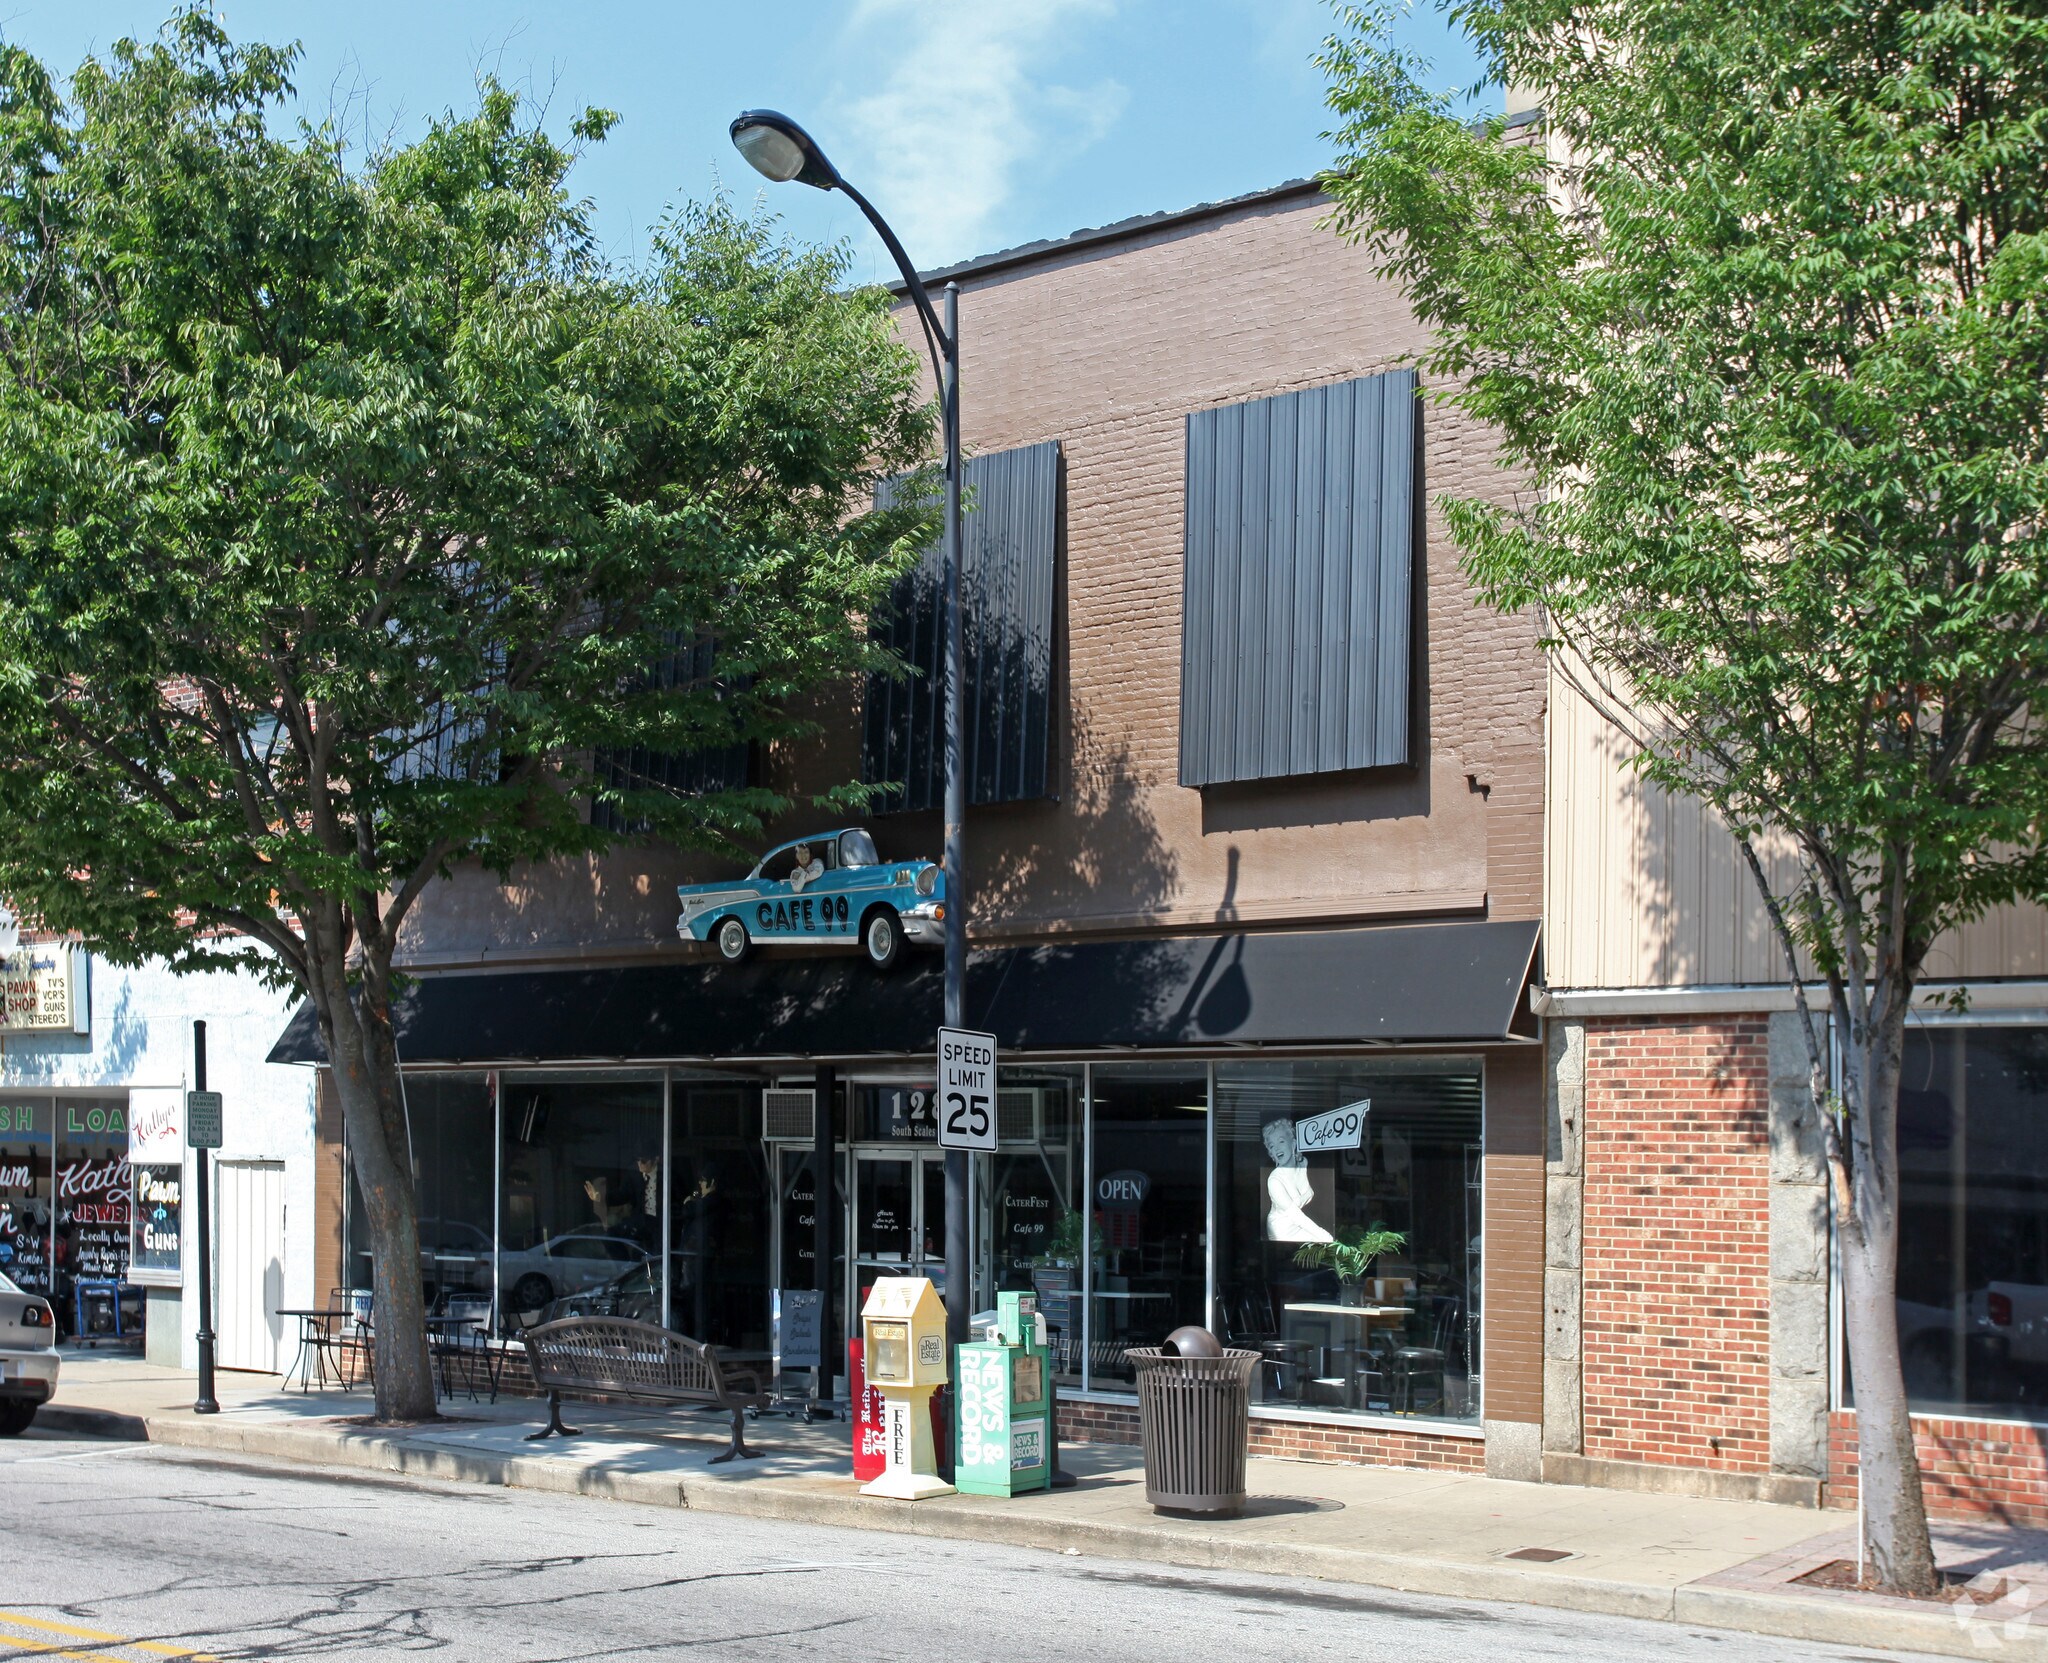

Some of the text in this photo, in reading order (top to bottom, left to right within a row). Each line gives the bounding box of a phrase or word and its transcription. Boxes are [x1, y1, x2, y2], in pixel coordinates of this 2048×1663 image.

[756, 896, 849, 932] CAFE 99
[7, 981, 36, 995] PAWN
[48, 978, 65, 988] TV'S
[42, 990, 66, 1000] VCR'S
[9, 998, 37, 1012] SHOP
[44, 1002, 66, 1012] GUNS
[29, 1014, 66, 1025] STEREO'S
[944, 1043, 992, 1066] SPEED
[949, 1068, 986, 1089] LIMIT
[0, 1106, 129, 1133] SH LOA
[946, 1092, 990, 1137] 25
[891, 1124, 937, 1137] South Scales
[139, 1171, 181, 1205] Pawn
[1099, 1179, 1142, 1200] OPEN
[1013, 1223, 1044, 1235] Cafe 99
[925, 1339, 940, 1350] Real
[920, 1350, 941, 1359] Estate
[959, 1349, 983, 1467] RECORD
[981, 1350, 1004, 1466] NEWS &
[862, 1428, 872, 1456] The
[893, 1409, 904, 1466] FREE
[1014, 1433, 1039, 1448] NEWS &
[1014, 1444, 1039, 1458] RECORD
